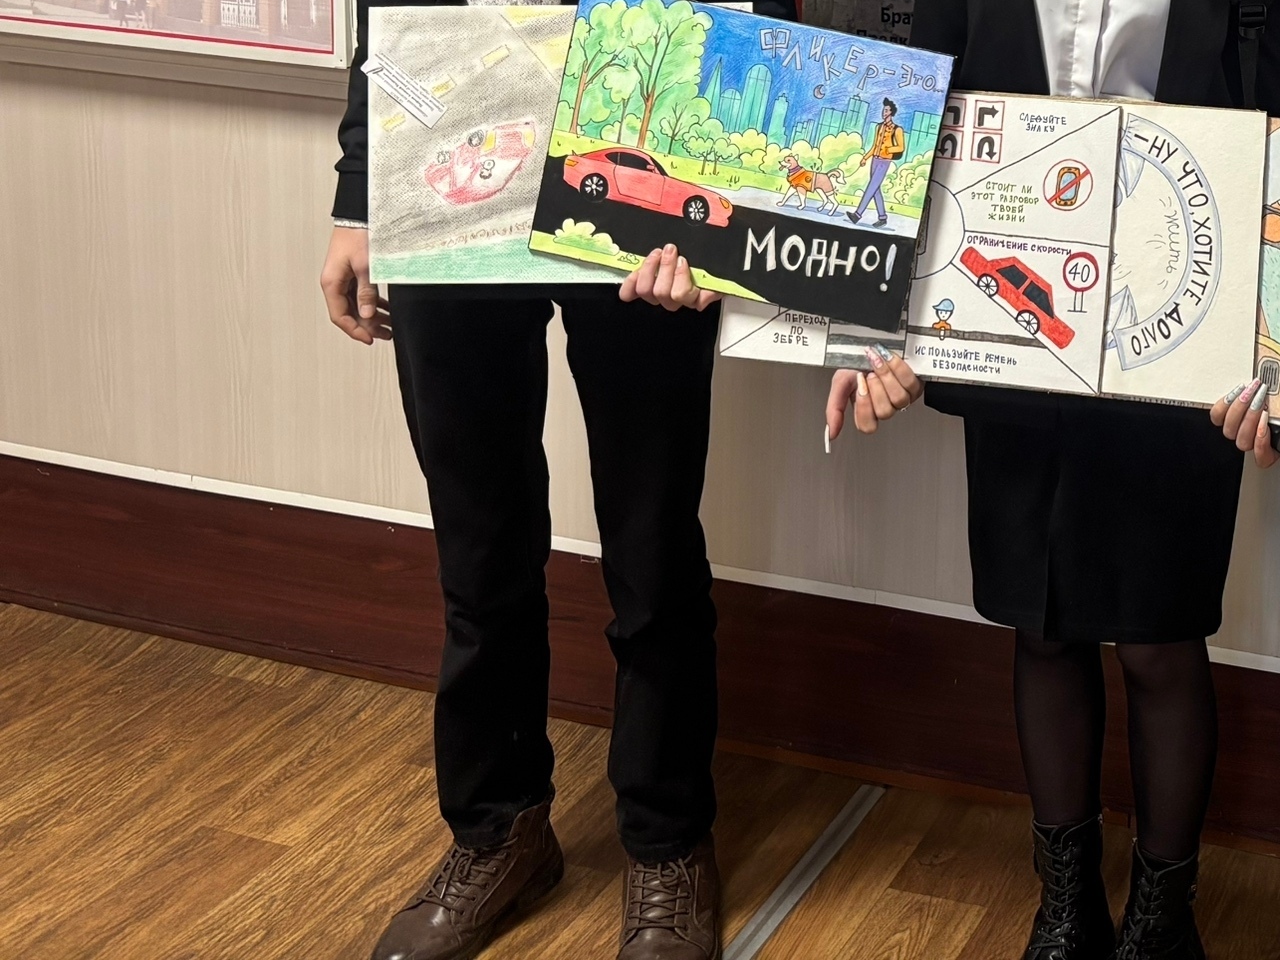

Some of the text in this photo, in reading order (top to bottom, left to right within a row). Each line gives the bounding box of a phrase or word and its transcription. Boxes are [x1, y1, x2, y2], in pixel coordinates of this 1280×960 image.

[1026, 123, 1055, 132] ЗНАКУ
[986, 181, 1016, 193] СТОИТ
[971, 192, 1039, 204] ЭТОТ РАЗГОВОР
[991, 204, 1023, 213] ТВОЕЙ
[988, 213, 1025, 222] ЖИЗНИ
[1031, 244, 1071, 255] СКОРОСТИ
[1183, 217, 1212, 306] ХОТИТЕ
[1069, 262, 1090, 282] 40
[784, 313, 828, 326] ПЕРЕХОД
[1131, 302, 1184, 355] ДОЛГО
[773, 333, 809, 346] ЗЕБРЕ
[985, 352, 1017, 366] РЕМЕНЬ
